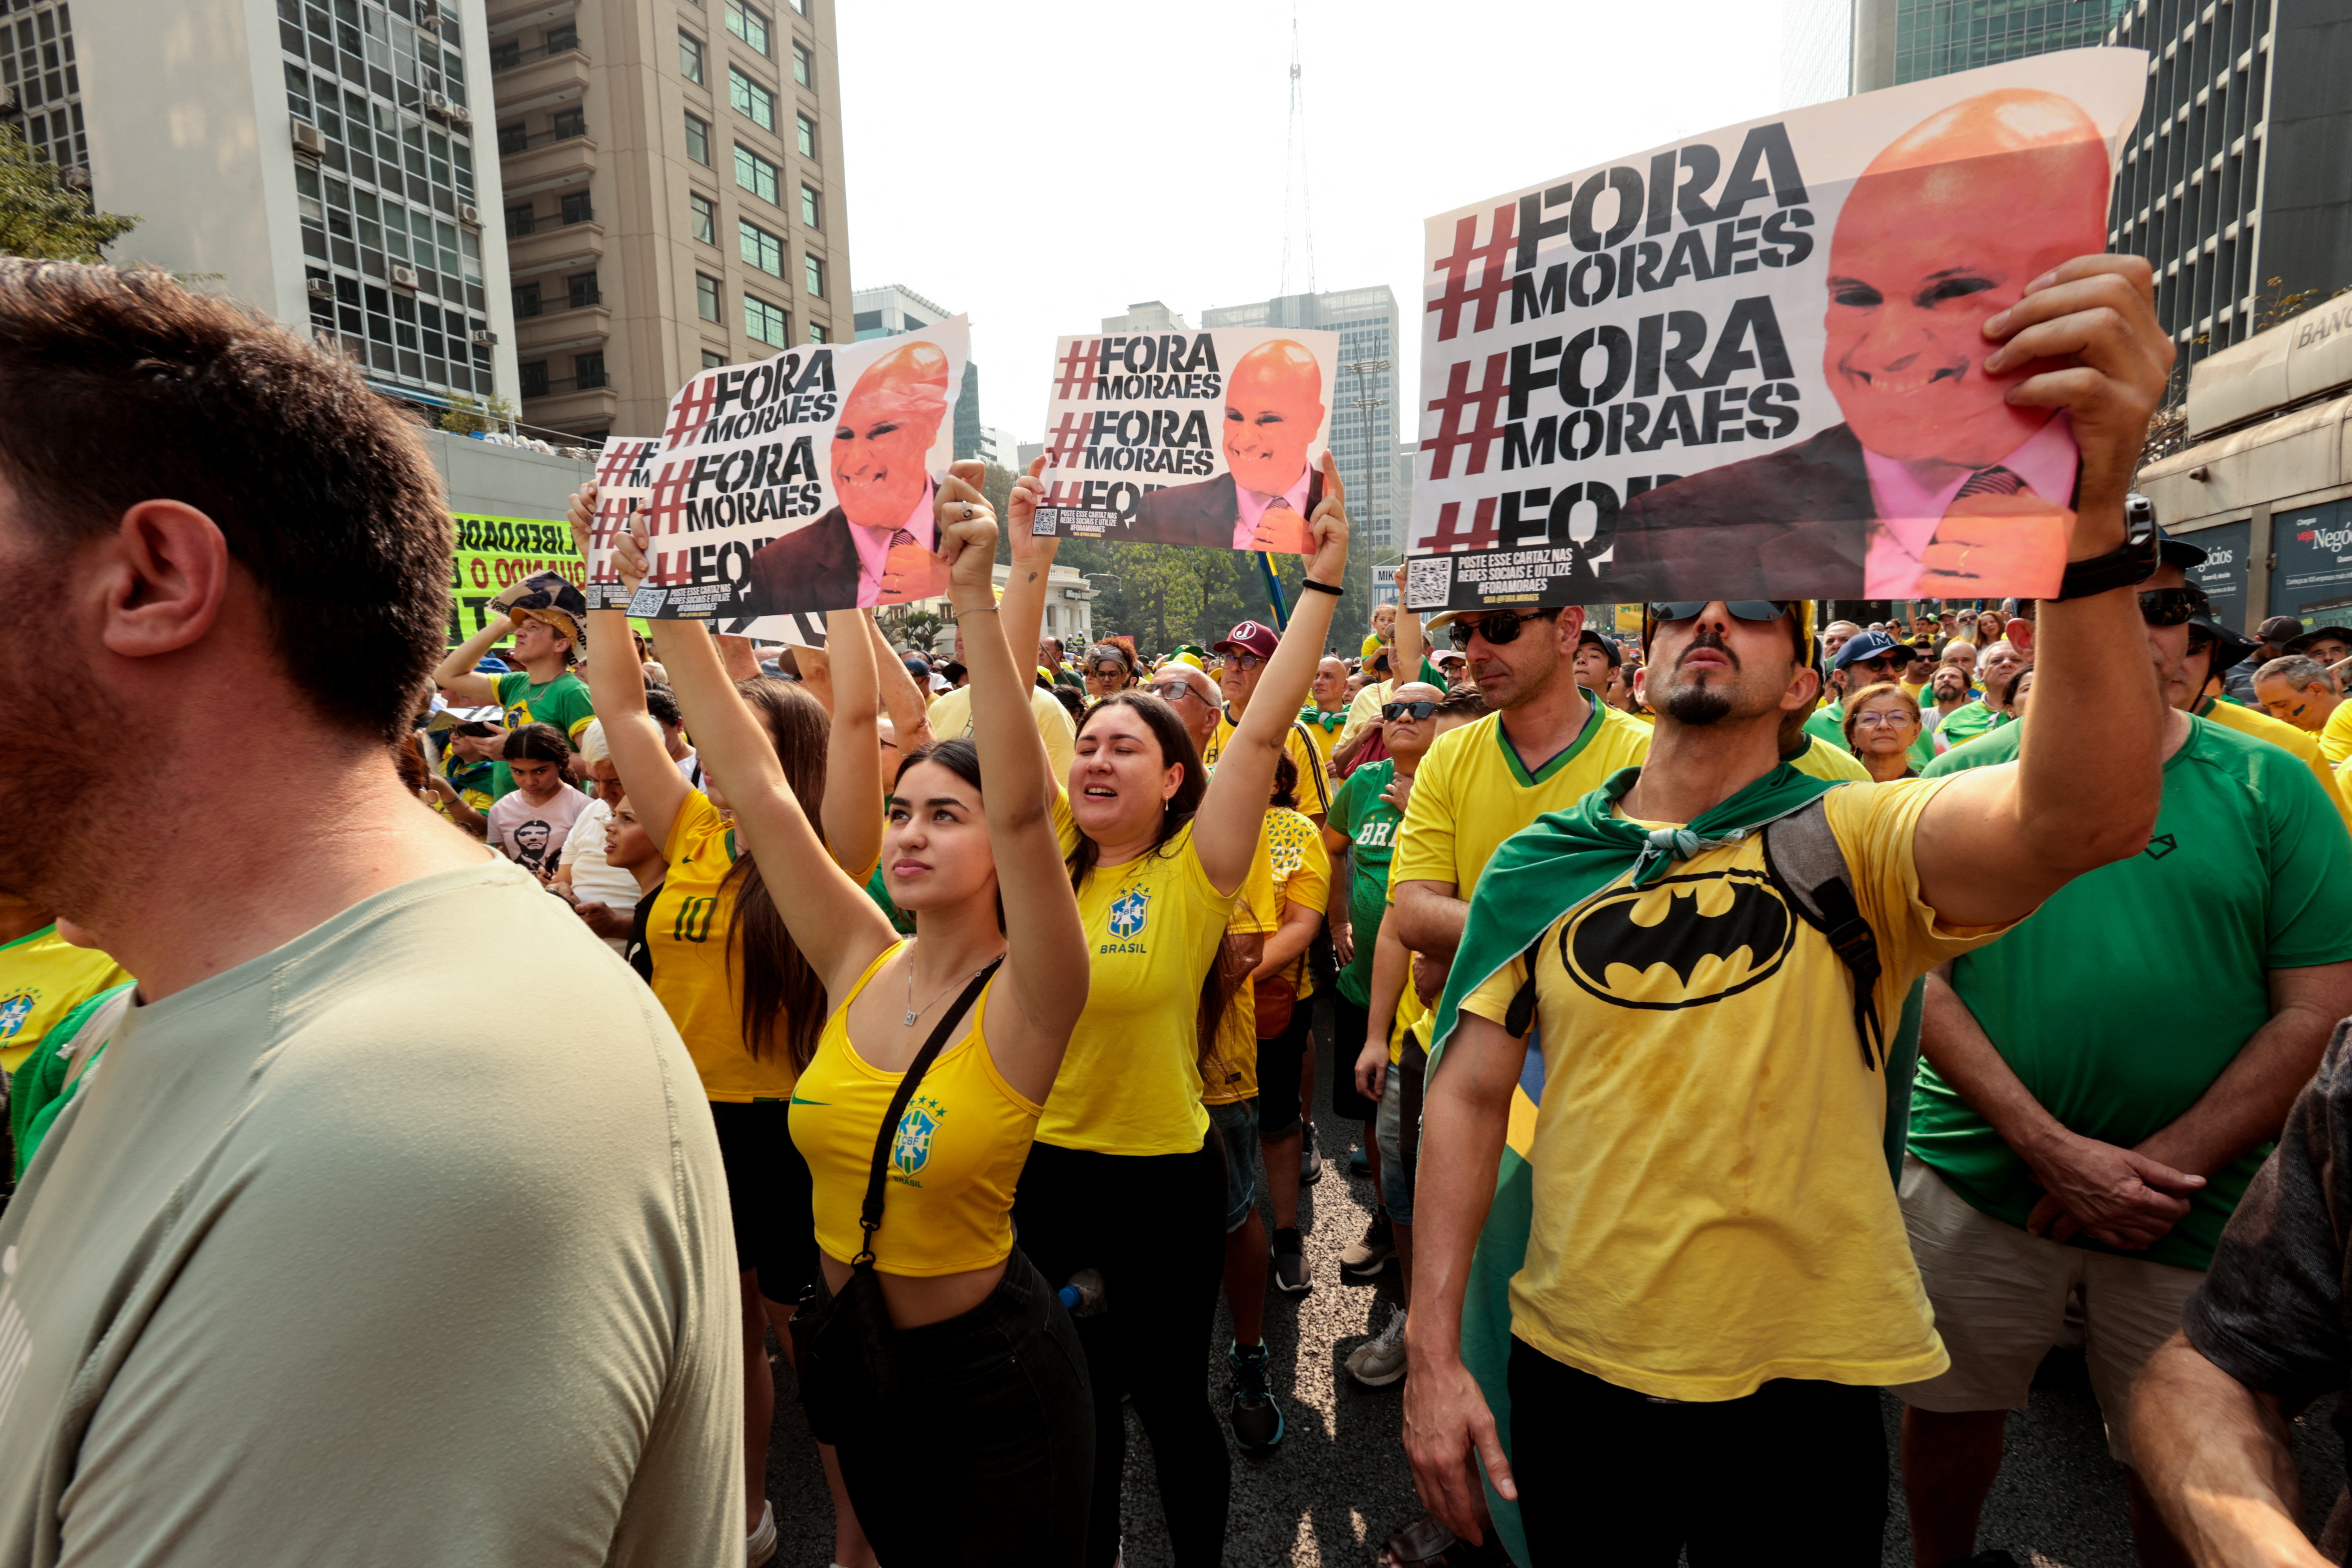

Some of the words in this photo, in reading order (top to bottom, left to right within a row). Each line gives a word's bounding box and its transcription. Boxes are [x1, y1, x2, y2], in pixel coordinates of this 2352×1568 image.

[1426, 124, 1809, 342] #FORA
[1510, 208, 1815, 325] MORAES
[1054, 333, 1220, 400] #FORA
[665, 349, 837, 451] #FORA
[1096, 373, 1222, 400] MORAES
[1421, 295, 1796, 480] #FORA
[702, 393, 838, 445] MORAES
[1501, 382, 1801, 471] MORAES
[1045, 409, 1212, 468] #FORA
[1084, 447, 1214, 476] MORAES
[643, 435, 819, 537] #FORA
[686, 482, 822, 533] MORAES
[1070, 524, 1105, 533] #FORAMORAES
[2312, 522, 2352, 552] Negó
[1457, 569, 1488, 582] REDES
[1488, 565, 1525, 580] SOCIAIS
[1526, 565, 1534, 578] E
[1534, 562, 1572, 577] UTILIZE
[1458, 555, 1488, 569] POSTE
[1488, 552, 1513, 567] ESSE
[1513, 549, 1551, 565] CARTAZ
[1551, 548, 1573, 562] NAS
[670, 588, 687, 597] POSTE
[687, 587, 700, 596] ESSE
[700, 585, 720, 595] CARTAZ
[720, 583, 731, 593] NAS
[686, 595, 706, 604] SOCIAIS
[711, 593, 731, 602] UTILIZE
[1477, 578, 1548, 594] #FORAMORAES
[673, 896, 716, 943] 10
[1119, 907, 1136, 918] CBF
[1100, 943, 1147, 954] BRASIL
[901, 1136, 920, 1146] CBF
[893, 1175, 923, 1188] BRASIL
